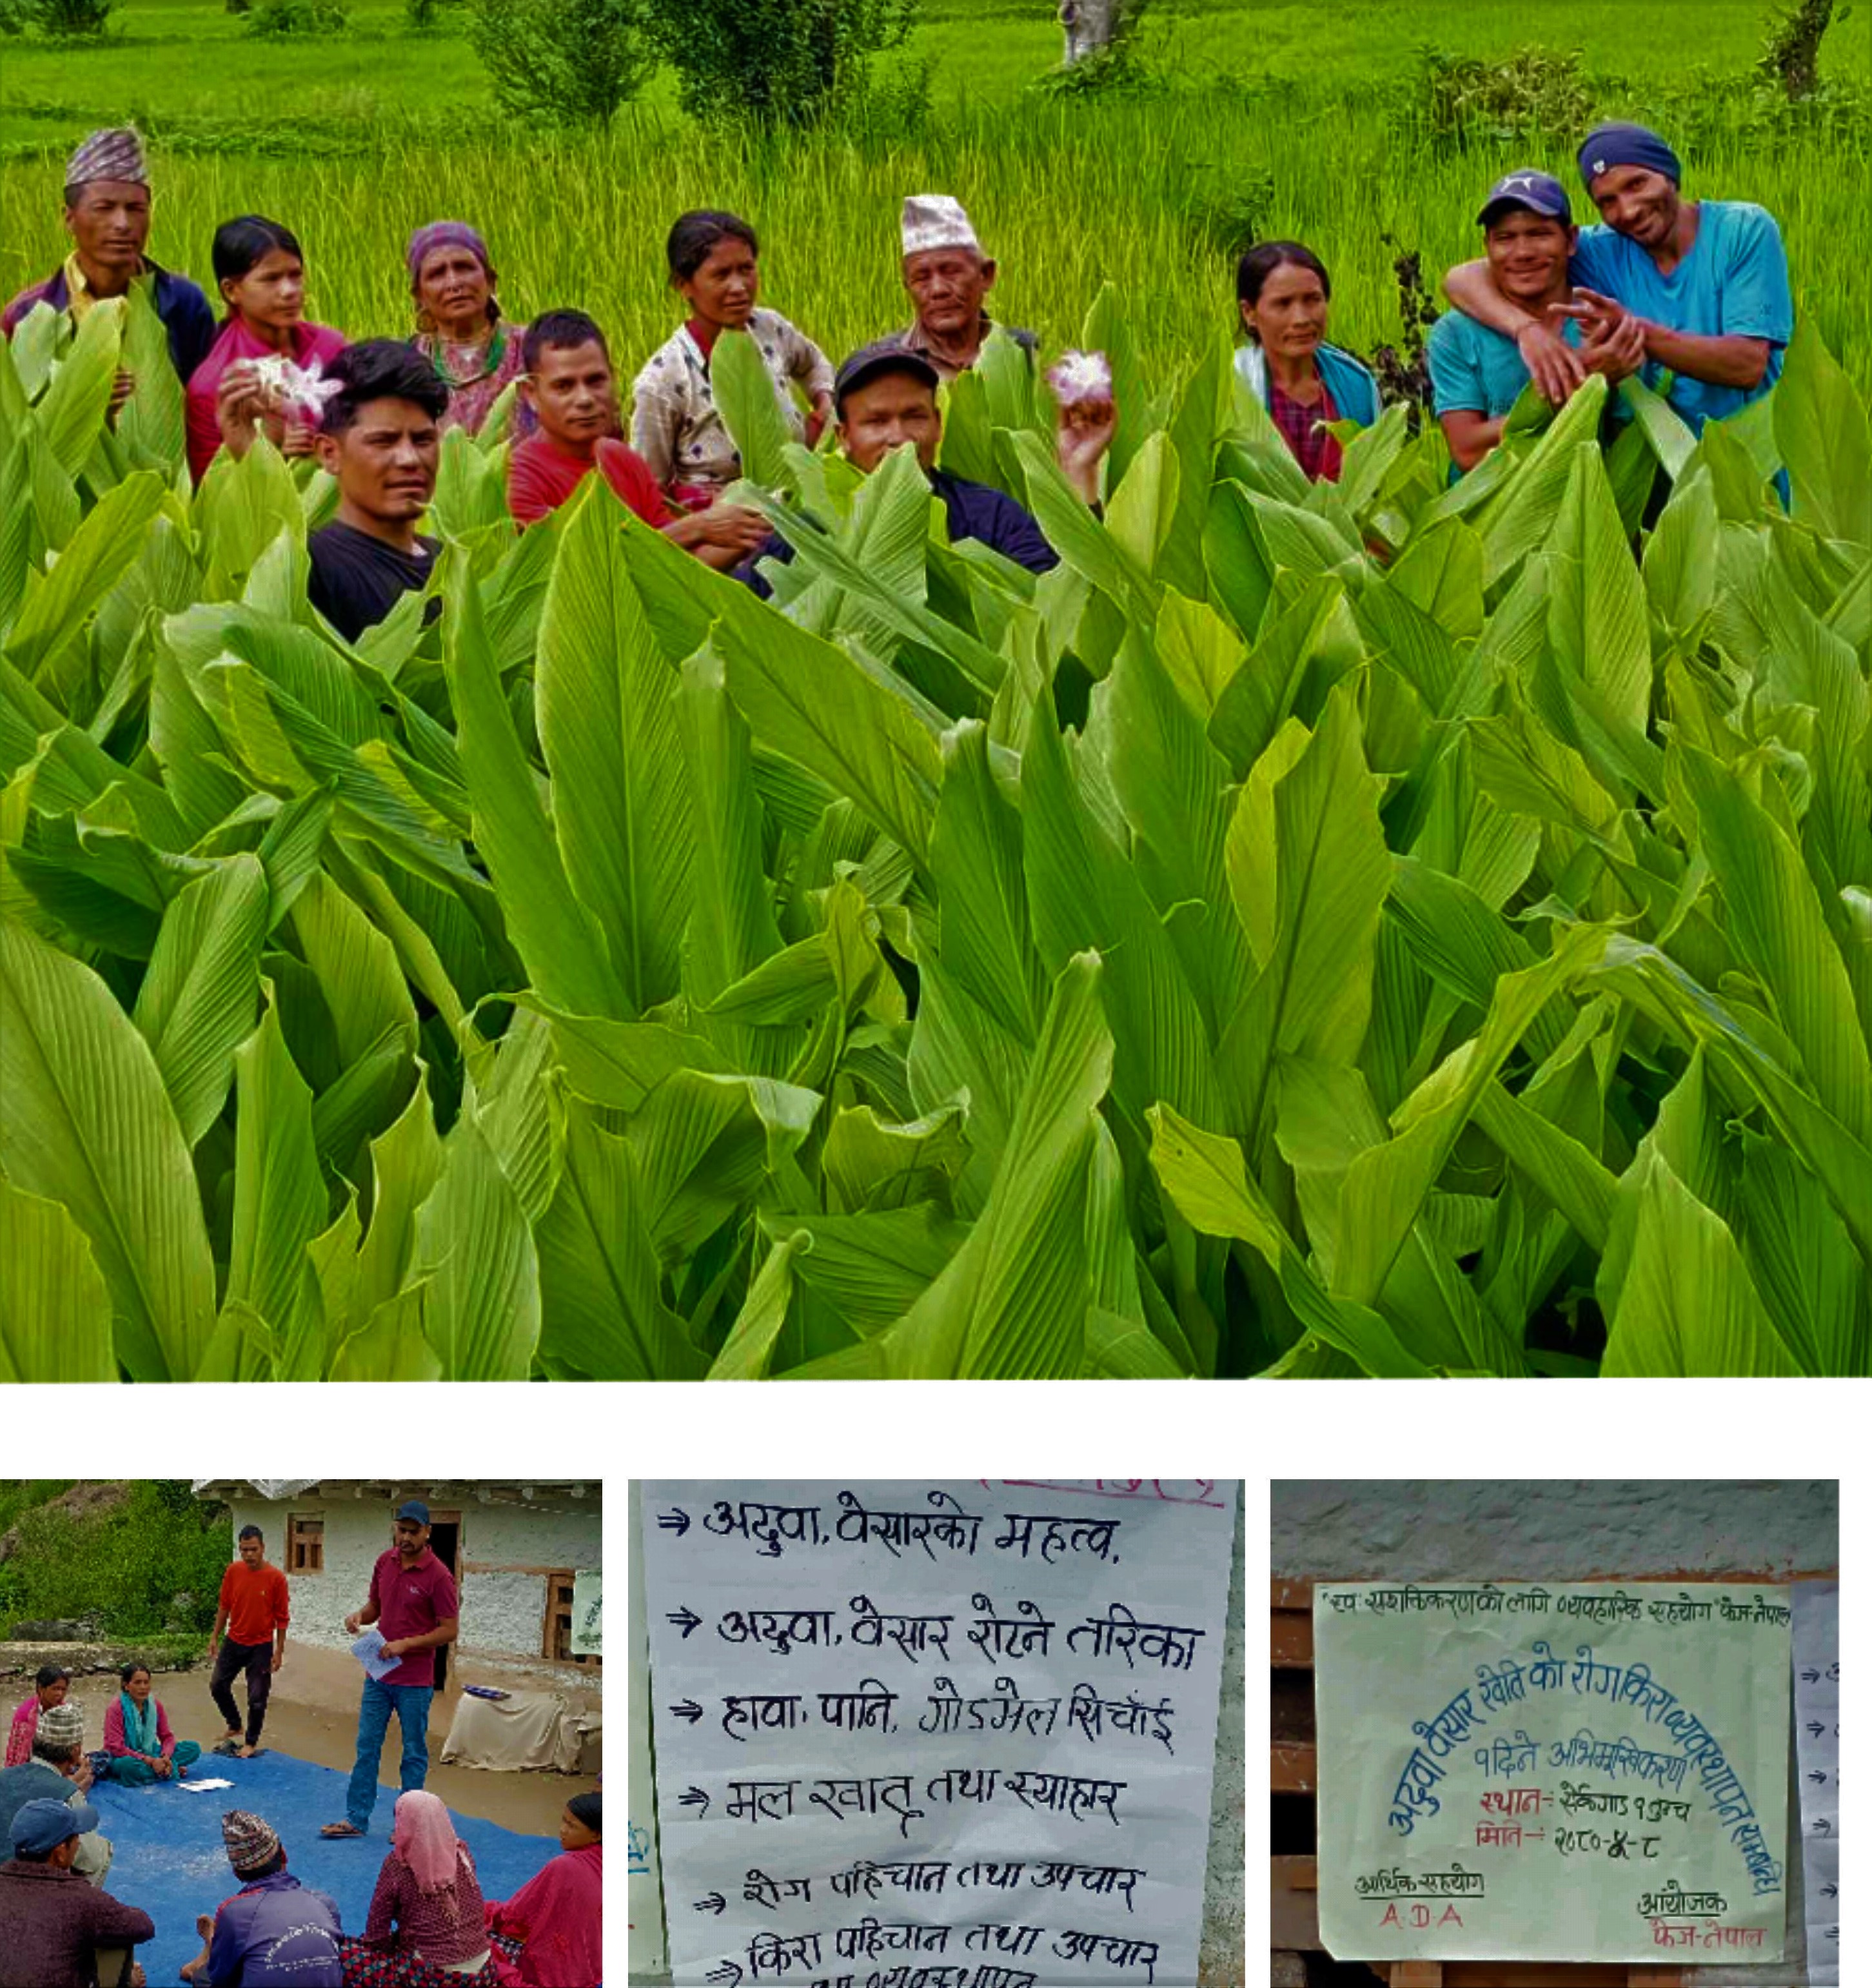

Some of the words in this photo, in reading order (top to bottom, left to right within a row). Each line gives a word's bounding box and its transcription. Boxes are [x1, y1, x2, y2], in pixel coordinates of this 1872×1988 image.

[1067, 1602, 1206, 1669] तरिका
[726, 1780, 802, 1824] मल
[927, 1769, 1001, 1804] तथा
[1004, 1772, 1128, 1826] स्याहार
[743, 1869, 811, 1910] रोग
[831, 1860, 952, 1900] पहिचान
[957, 1860, 1026, 1889] तथा
[1031, 1861, 1147, 1913] उपचार
[1419, 1863, 1484, 1895] सहयोग
[745, 1933, 822, 1979] किरा
[836, 1918, 952, 1961] पहिचान
[965, 1924, 1045, 1955] तथा
[1052, 1931, 1159, 1984] उपचार
